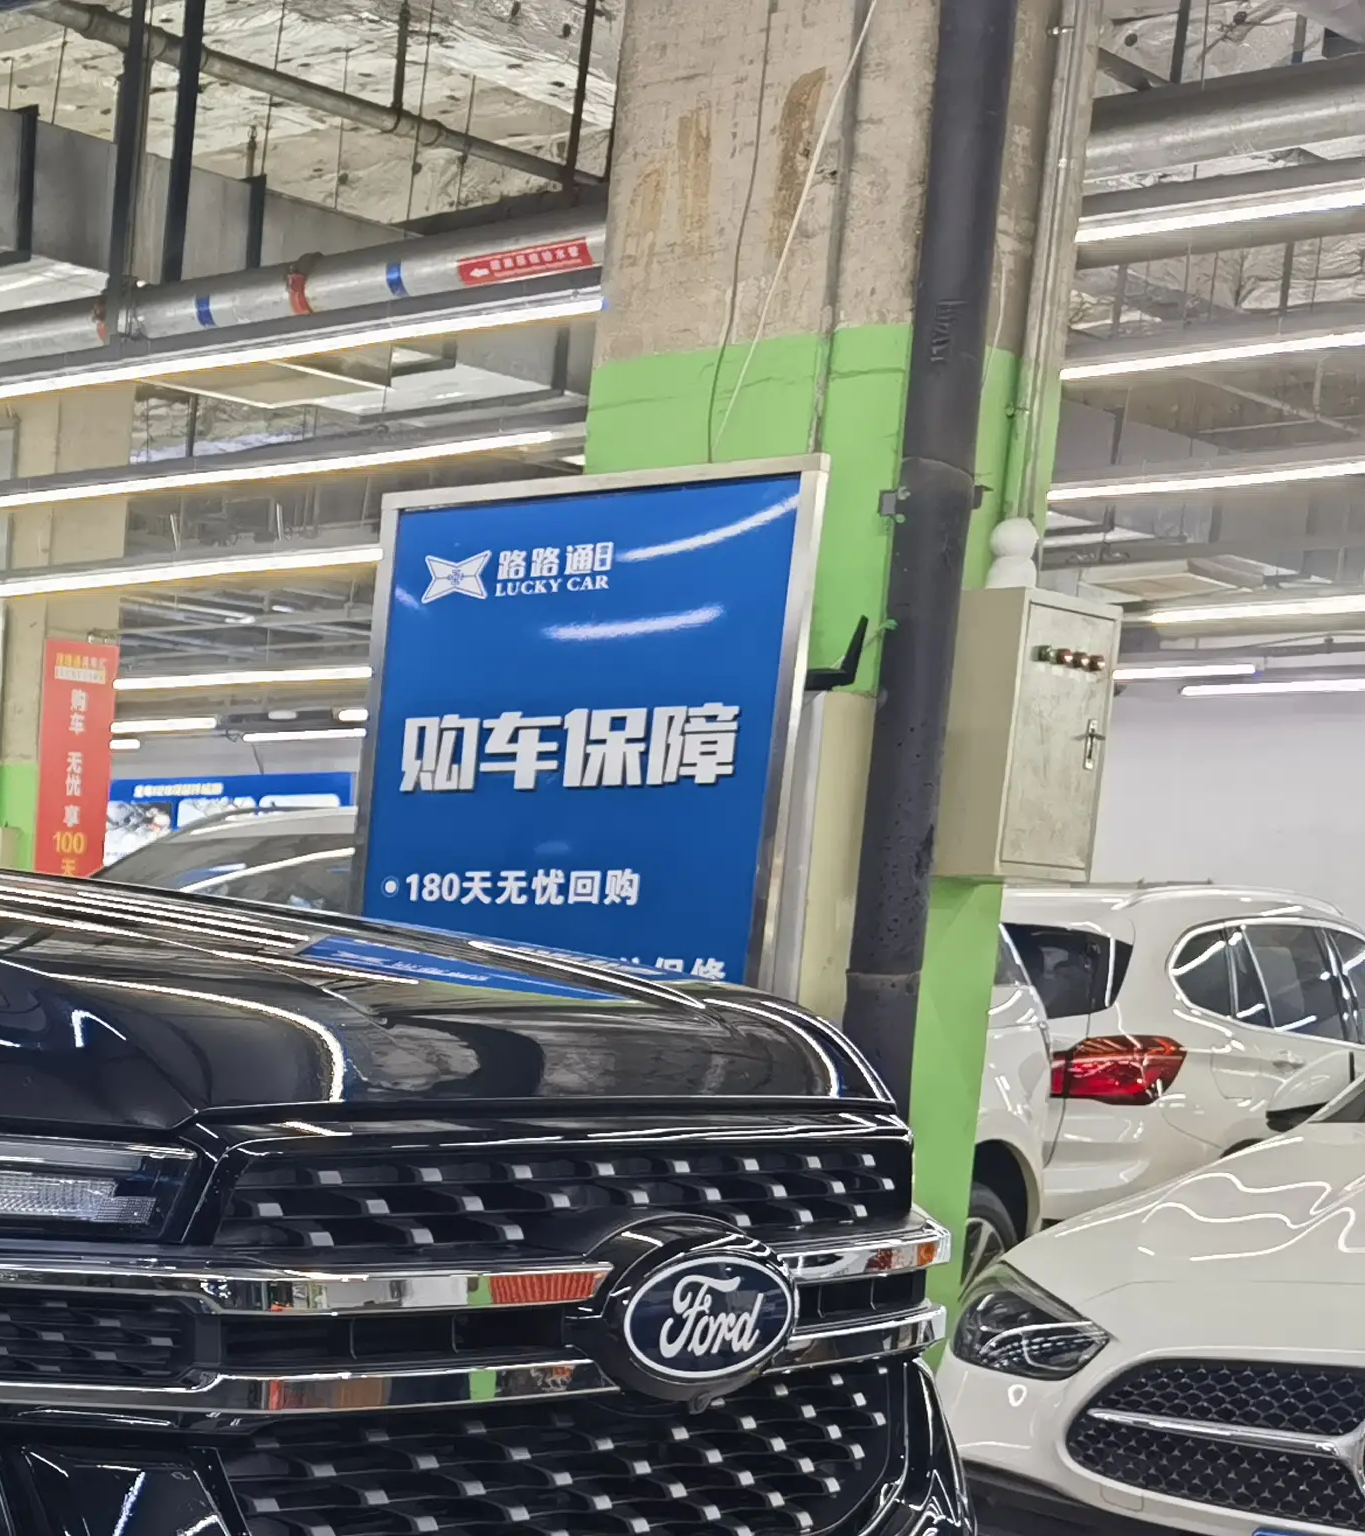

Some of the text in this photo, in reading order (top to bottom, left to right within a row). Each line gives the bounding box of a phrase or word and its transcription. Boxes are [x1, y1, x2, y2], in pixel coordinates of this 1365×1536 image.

[494, 575, 610, 597] LUCKY CAR
[399, 702, 741, 793] 购车保障
[405, 869, 640, 906] 180天无忧回购
[659, 1275, 764, 1359] Ford
